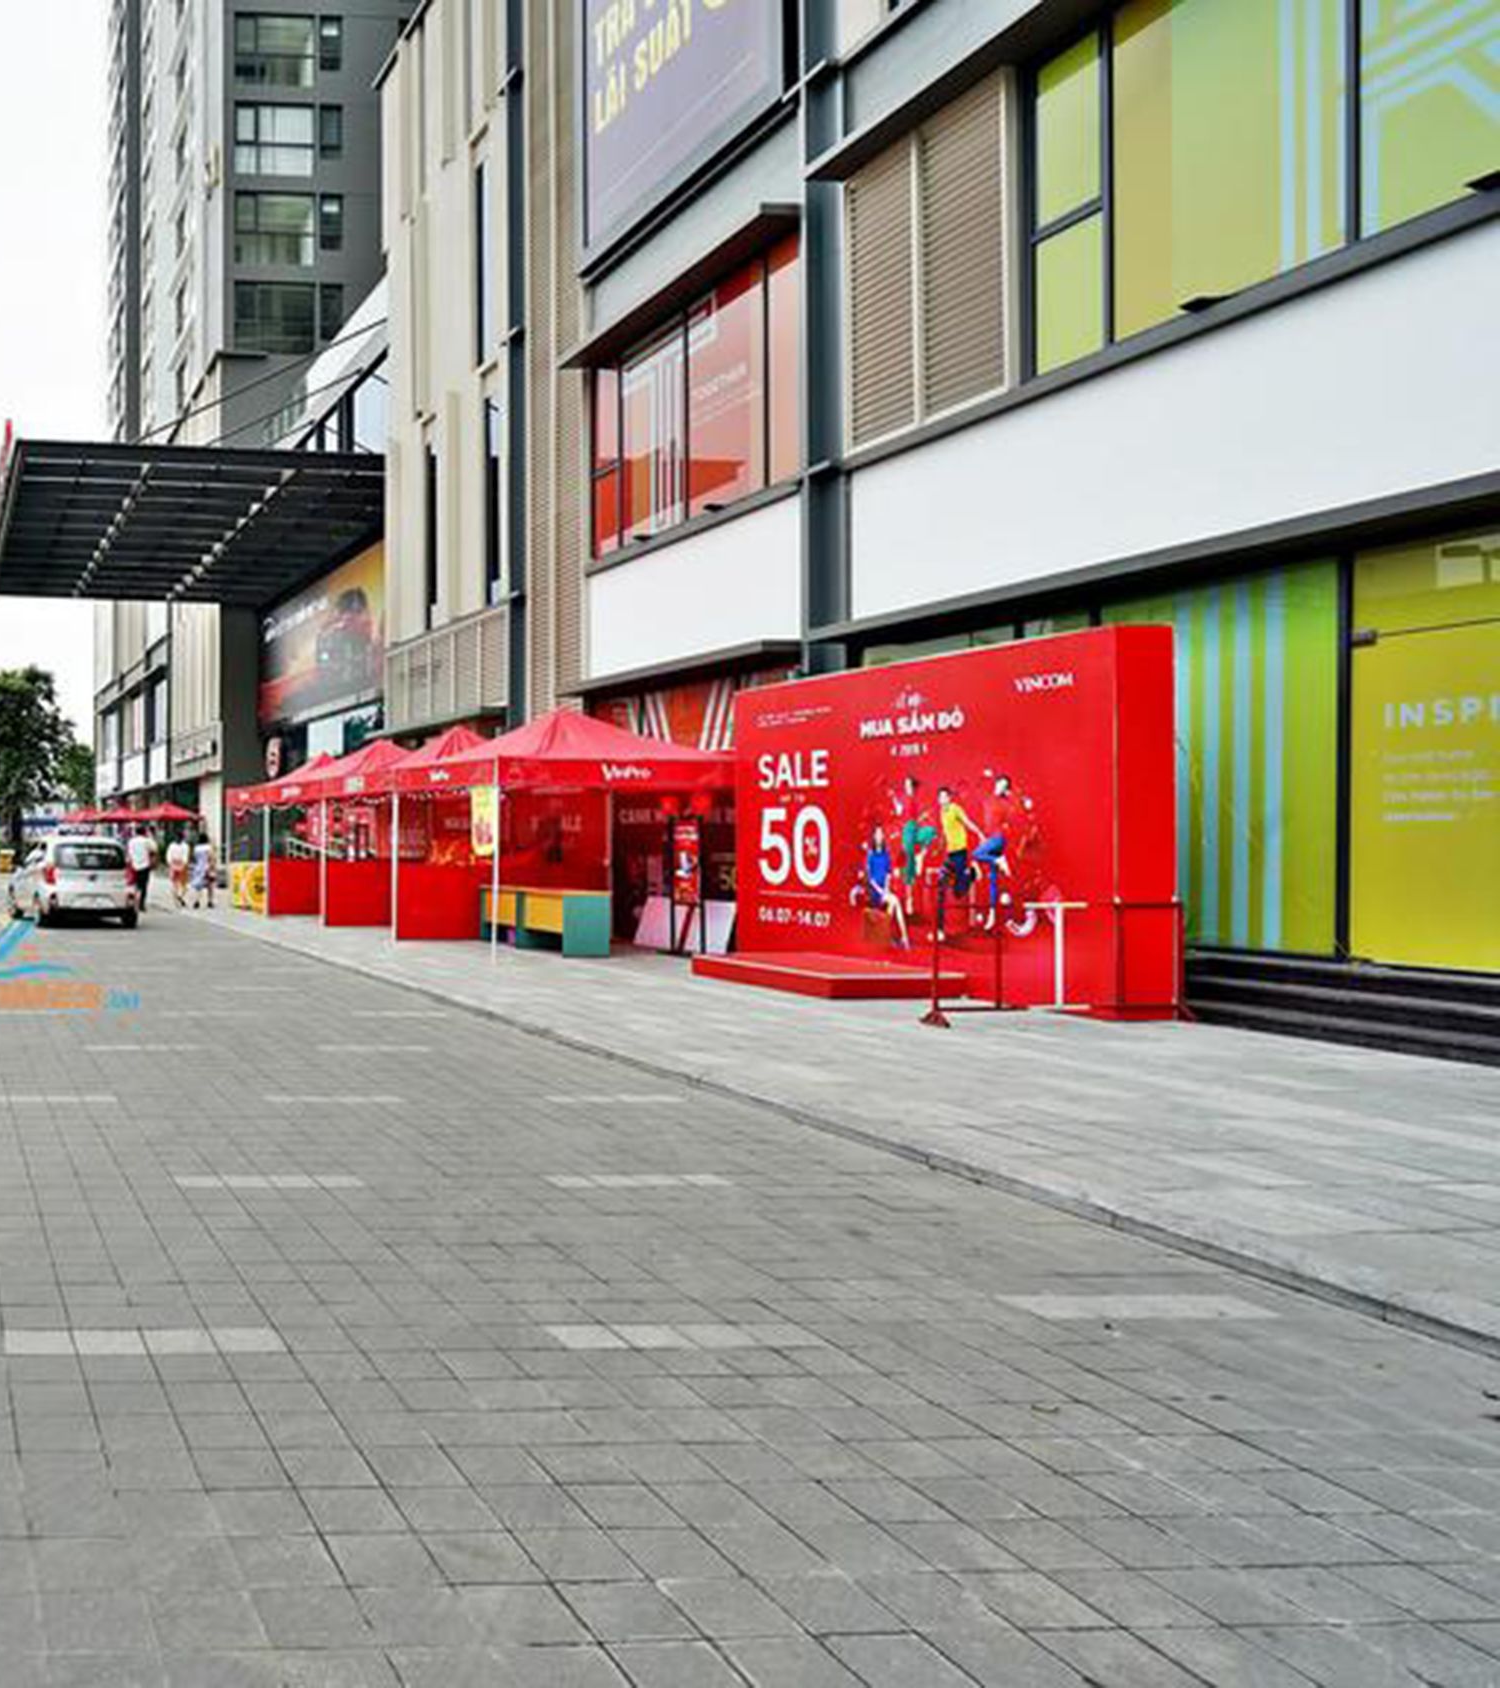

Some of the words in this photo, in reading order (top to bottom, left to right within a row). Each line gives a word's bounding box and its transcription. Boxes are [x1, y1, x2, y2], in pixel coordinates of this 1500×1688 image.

[1013, 672, 1073, 692] VINCOM
[858, 718, 894, 740] MUA
[758, 750, 830, 789] SALE
